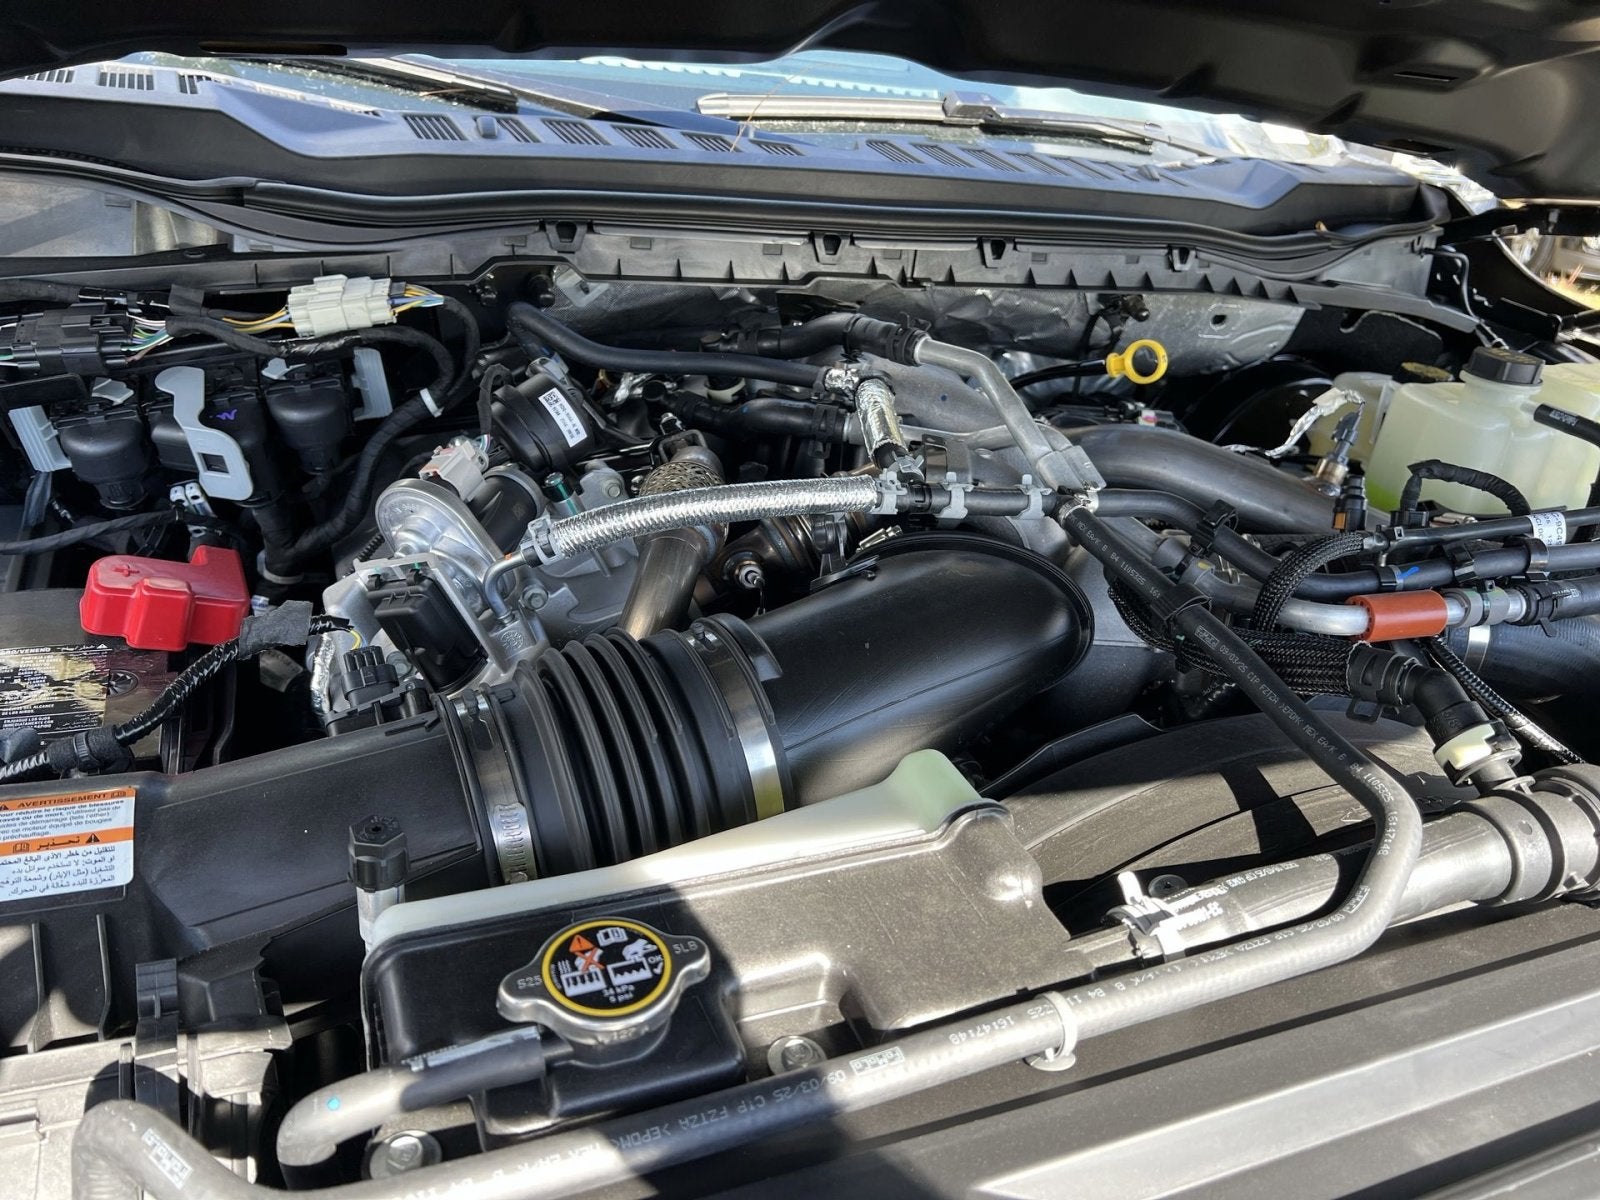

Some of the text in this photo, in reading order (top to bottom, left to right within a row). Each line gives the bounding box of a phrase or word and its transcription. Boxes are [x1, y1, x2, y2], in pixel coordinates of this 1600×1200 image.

[17, 793, 107, 808] AVERTISSEMENT
[53, 804, 76, 812] risque
[89, 799, 124, 808] blessures
[85, 817, 113, 825] bougies
[81, 849, 93, 857] من
[647, 955, 663, 965] OK
[772, 1069, 847, 1099] 09/03/25
[678, 1111, 729, 1131] FZTZA
